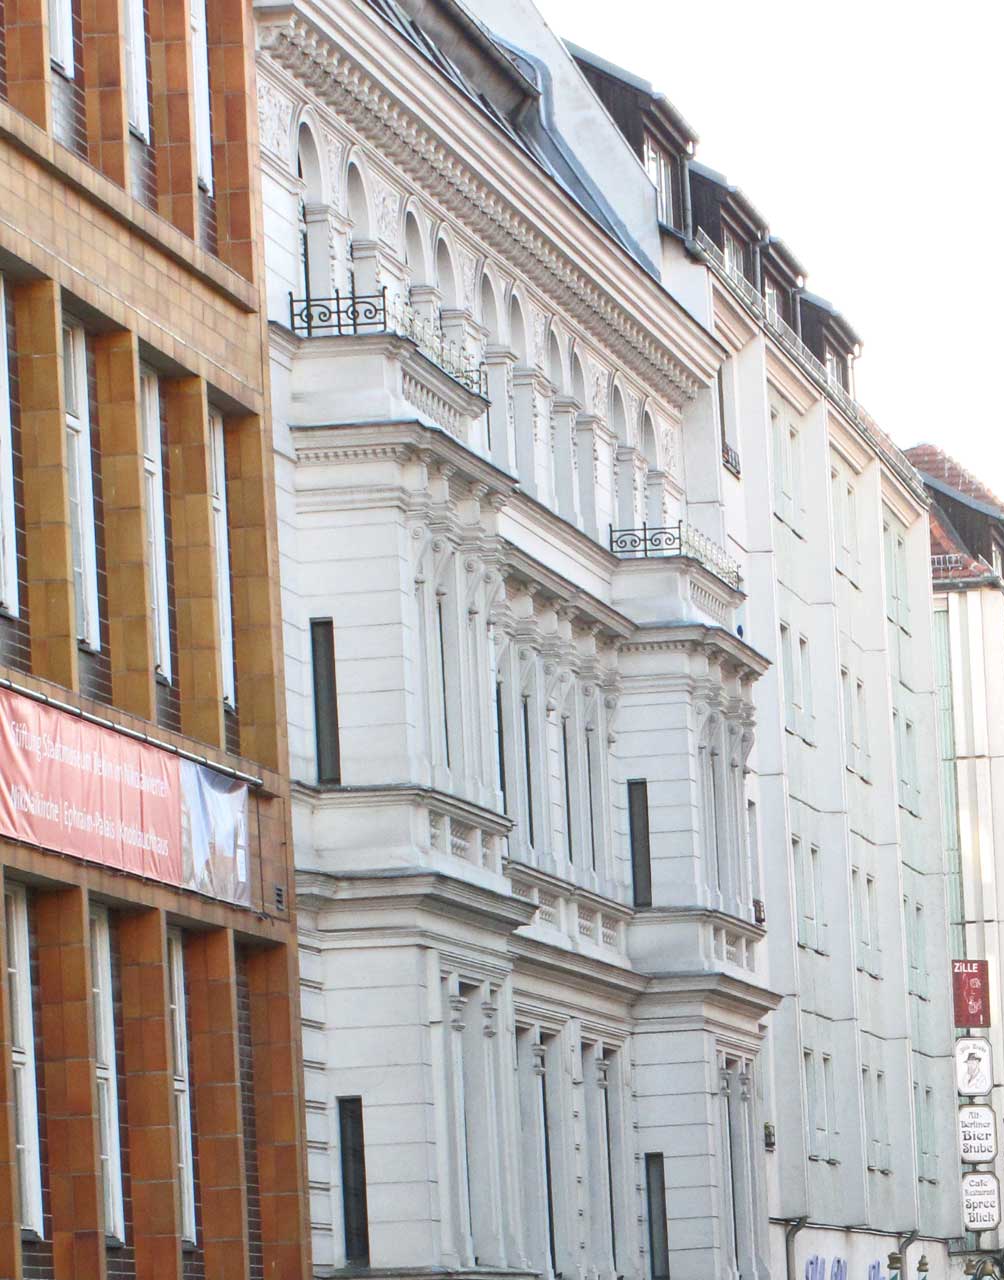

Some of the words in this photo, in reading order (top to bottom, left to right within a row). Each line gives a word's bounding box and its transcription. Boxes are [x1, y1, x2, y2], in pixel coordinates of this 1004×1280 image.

[961, 1130, 992, 1141] Bier
[962, 1142, 993, 1154] Stube
[965, 1199, 996, 1212] Spree
[968, 1211, 995, 1223] Blick
